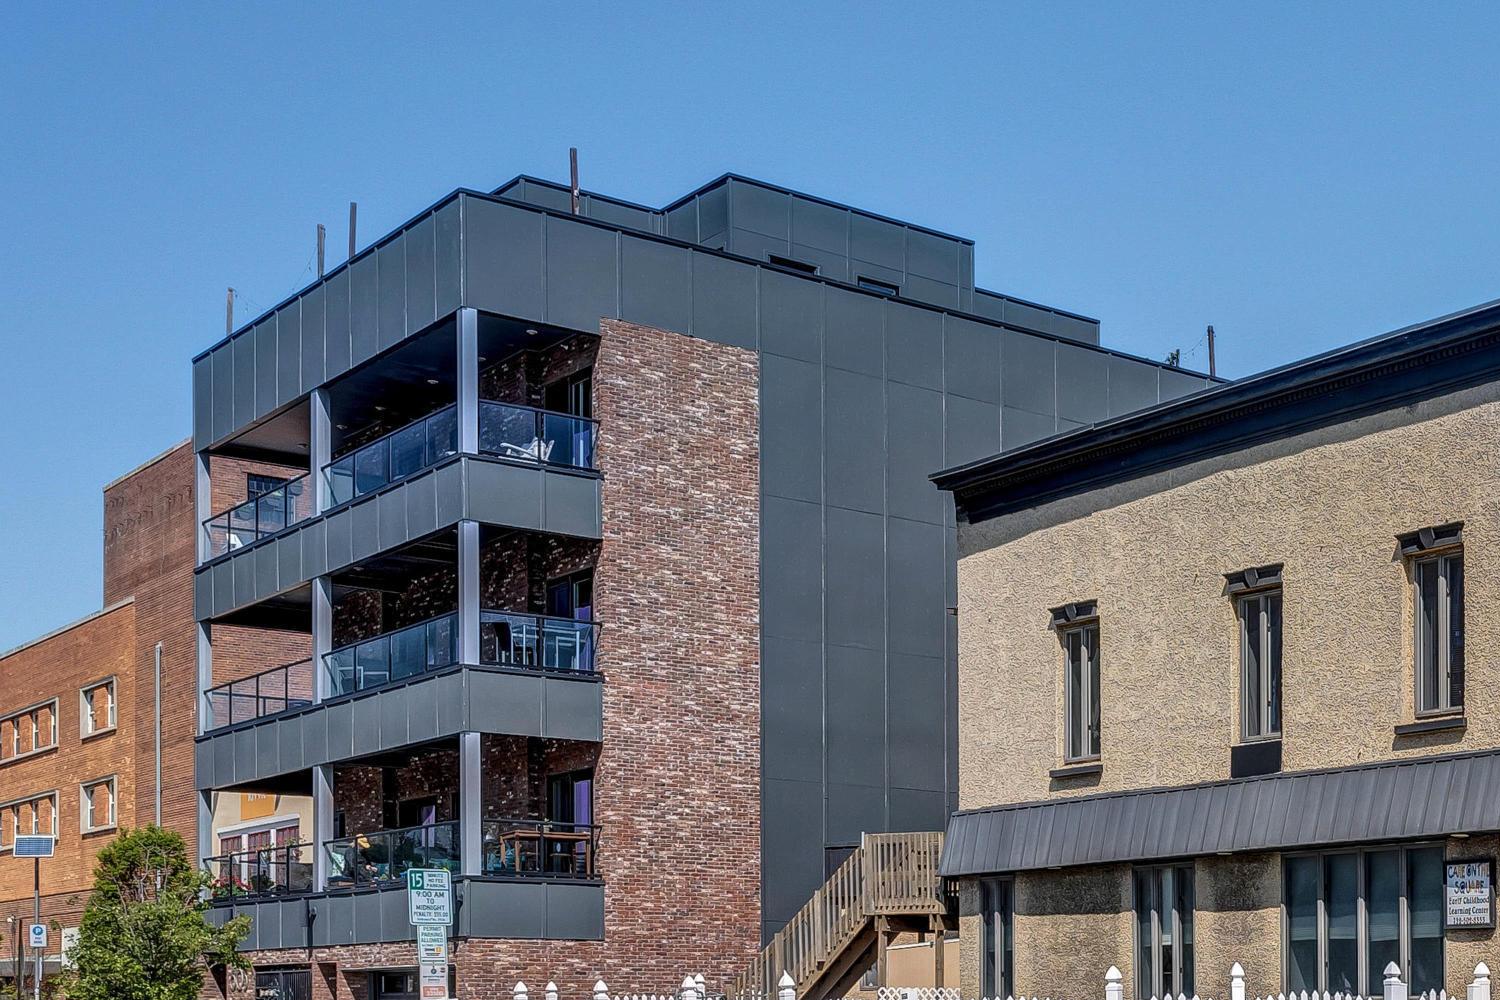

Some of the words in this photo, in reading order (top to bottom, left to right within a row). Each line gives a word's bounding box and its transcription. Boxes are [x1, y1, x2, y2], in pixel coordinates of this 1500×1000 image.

[1447, 865, 1466, 880] CARE
[411, 873, 423, 888] 15
[1454, 880, 1485, 895] SQUARE
[426, 897, 435, 905] TO
[1463, 896, 1489, 905] Childhood
[415, 904, 446, 912] MIDNIGHT
[1449, 907, 1471, 916] Learning
[1472, 906, 1489, 915] Center
